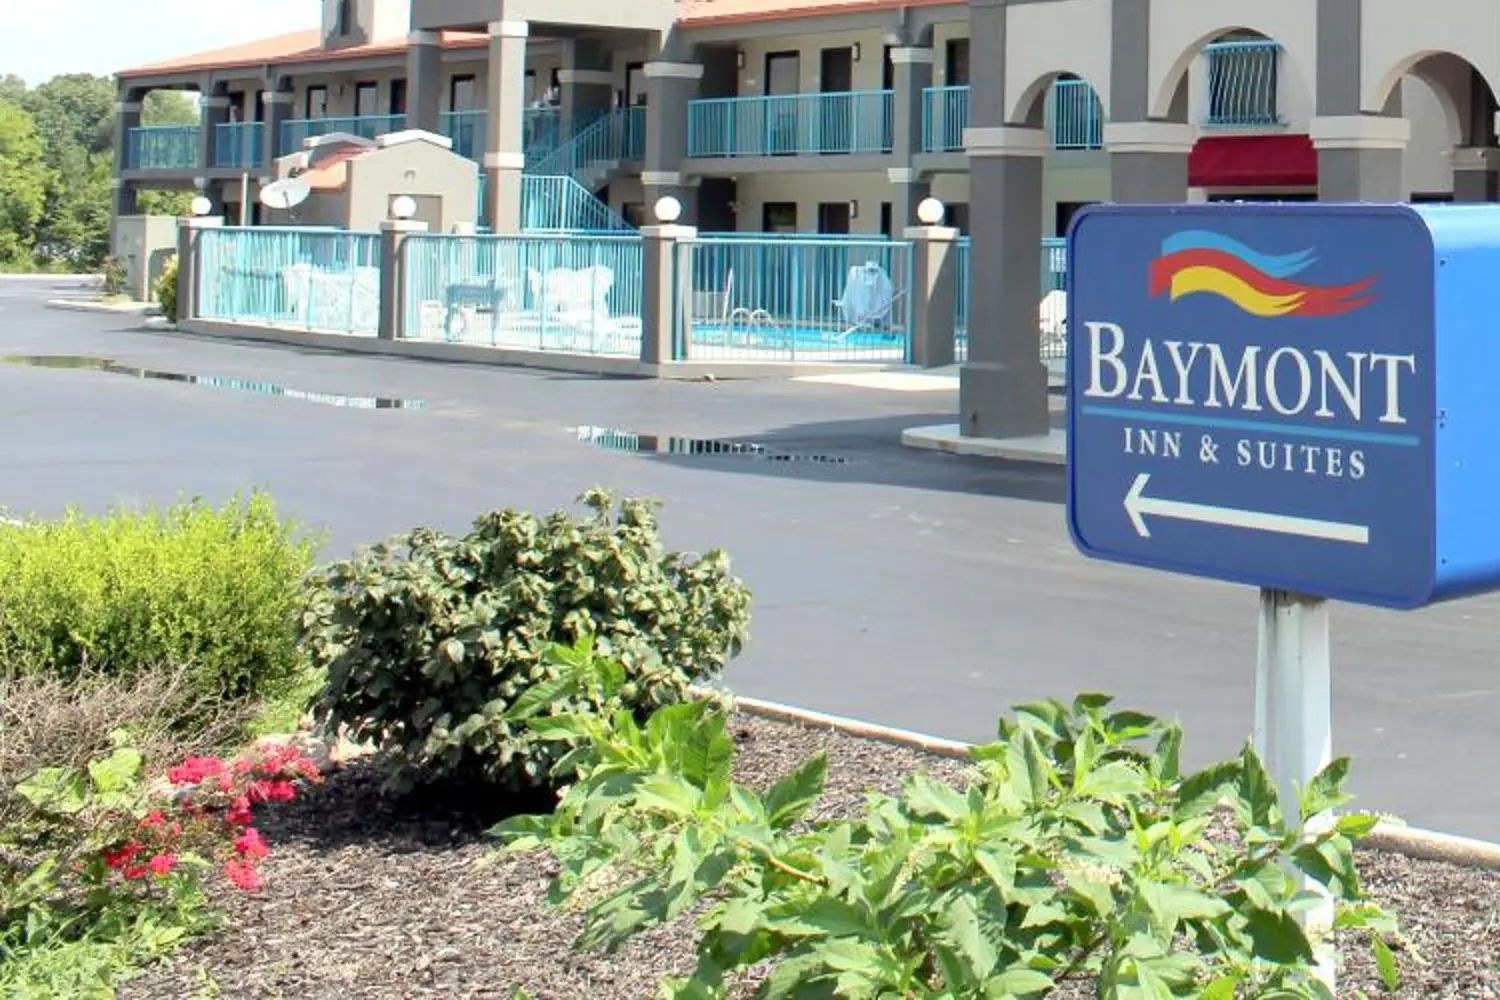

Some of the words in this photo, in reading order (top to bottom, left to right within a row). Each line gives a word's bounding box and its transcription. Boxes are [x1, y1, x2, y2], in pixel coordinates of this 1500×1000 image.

[1083, 320, 1416, 424] BAYMONT
[1123, 427, 1181, 457] INN
[1200, 434, 1219, 464] &
[1237, 439, 1366, 479] SUITES
